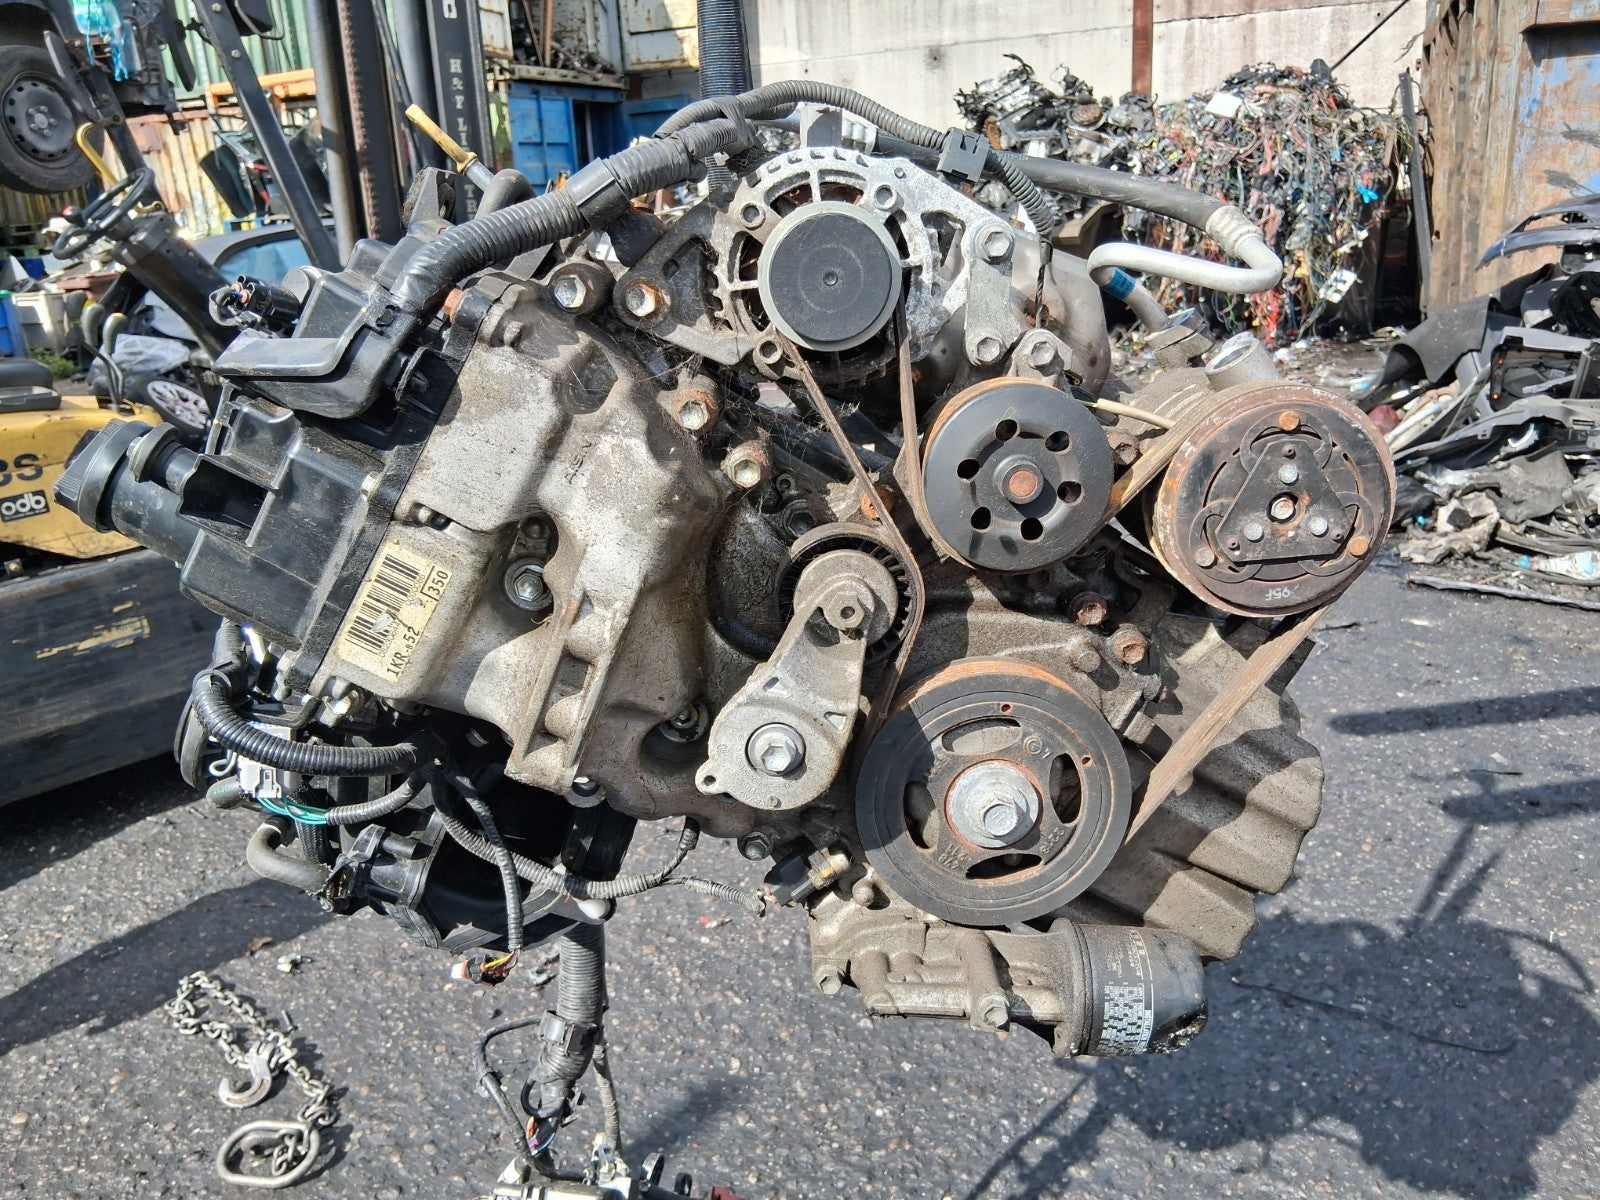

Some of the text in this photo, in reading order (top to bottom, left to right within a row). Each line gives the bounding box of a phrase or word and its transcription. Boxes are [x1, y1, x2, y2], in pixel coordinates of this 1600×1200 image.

[449, 58, 462, 73] H
[452, 77, 464, 91] &
[0, 492, 46, 516] odb
[428, 569, 449, 596] 350
